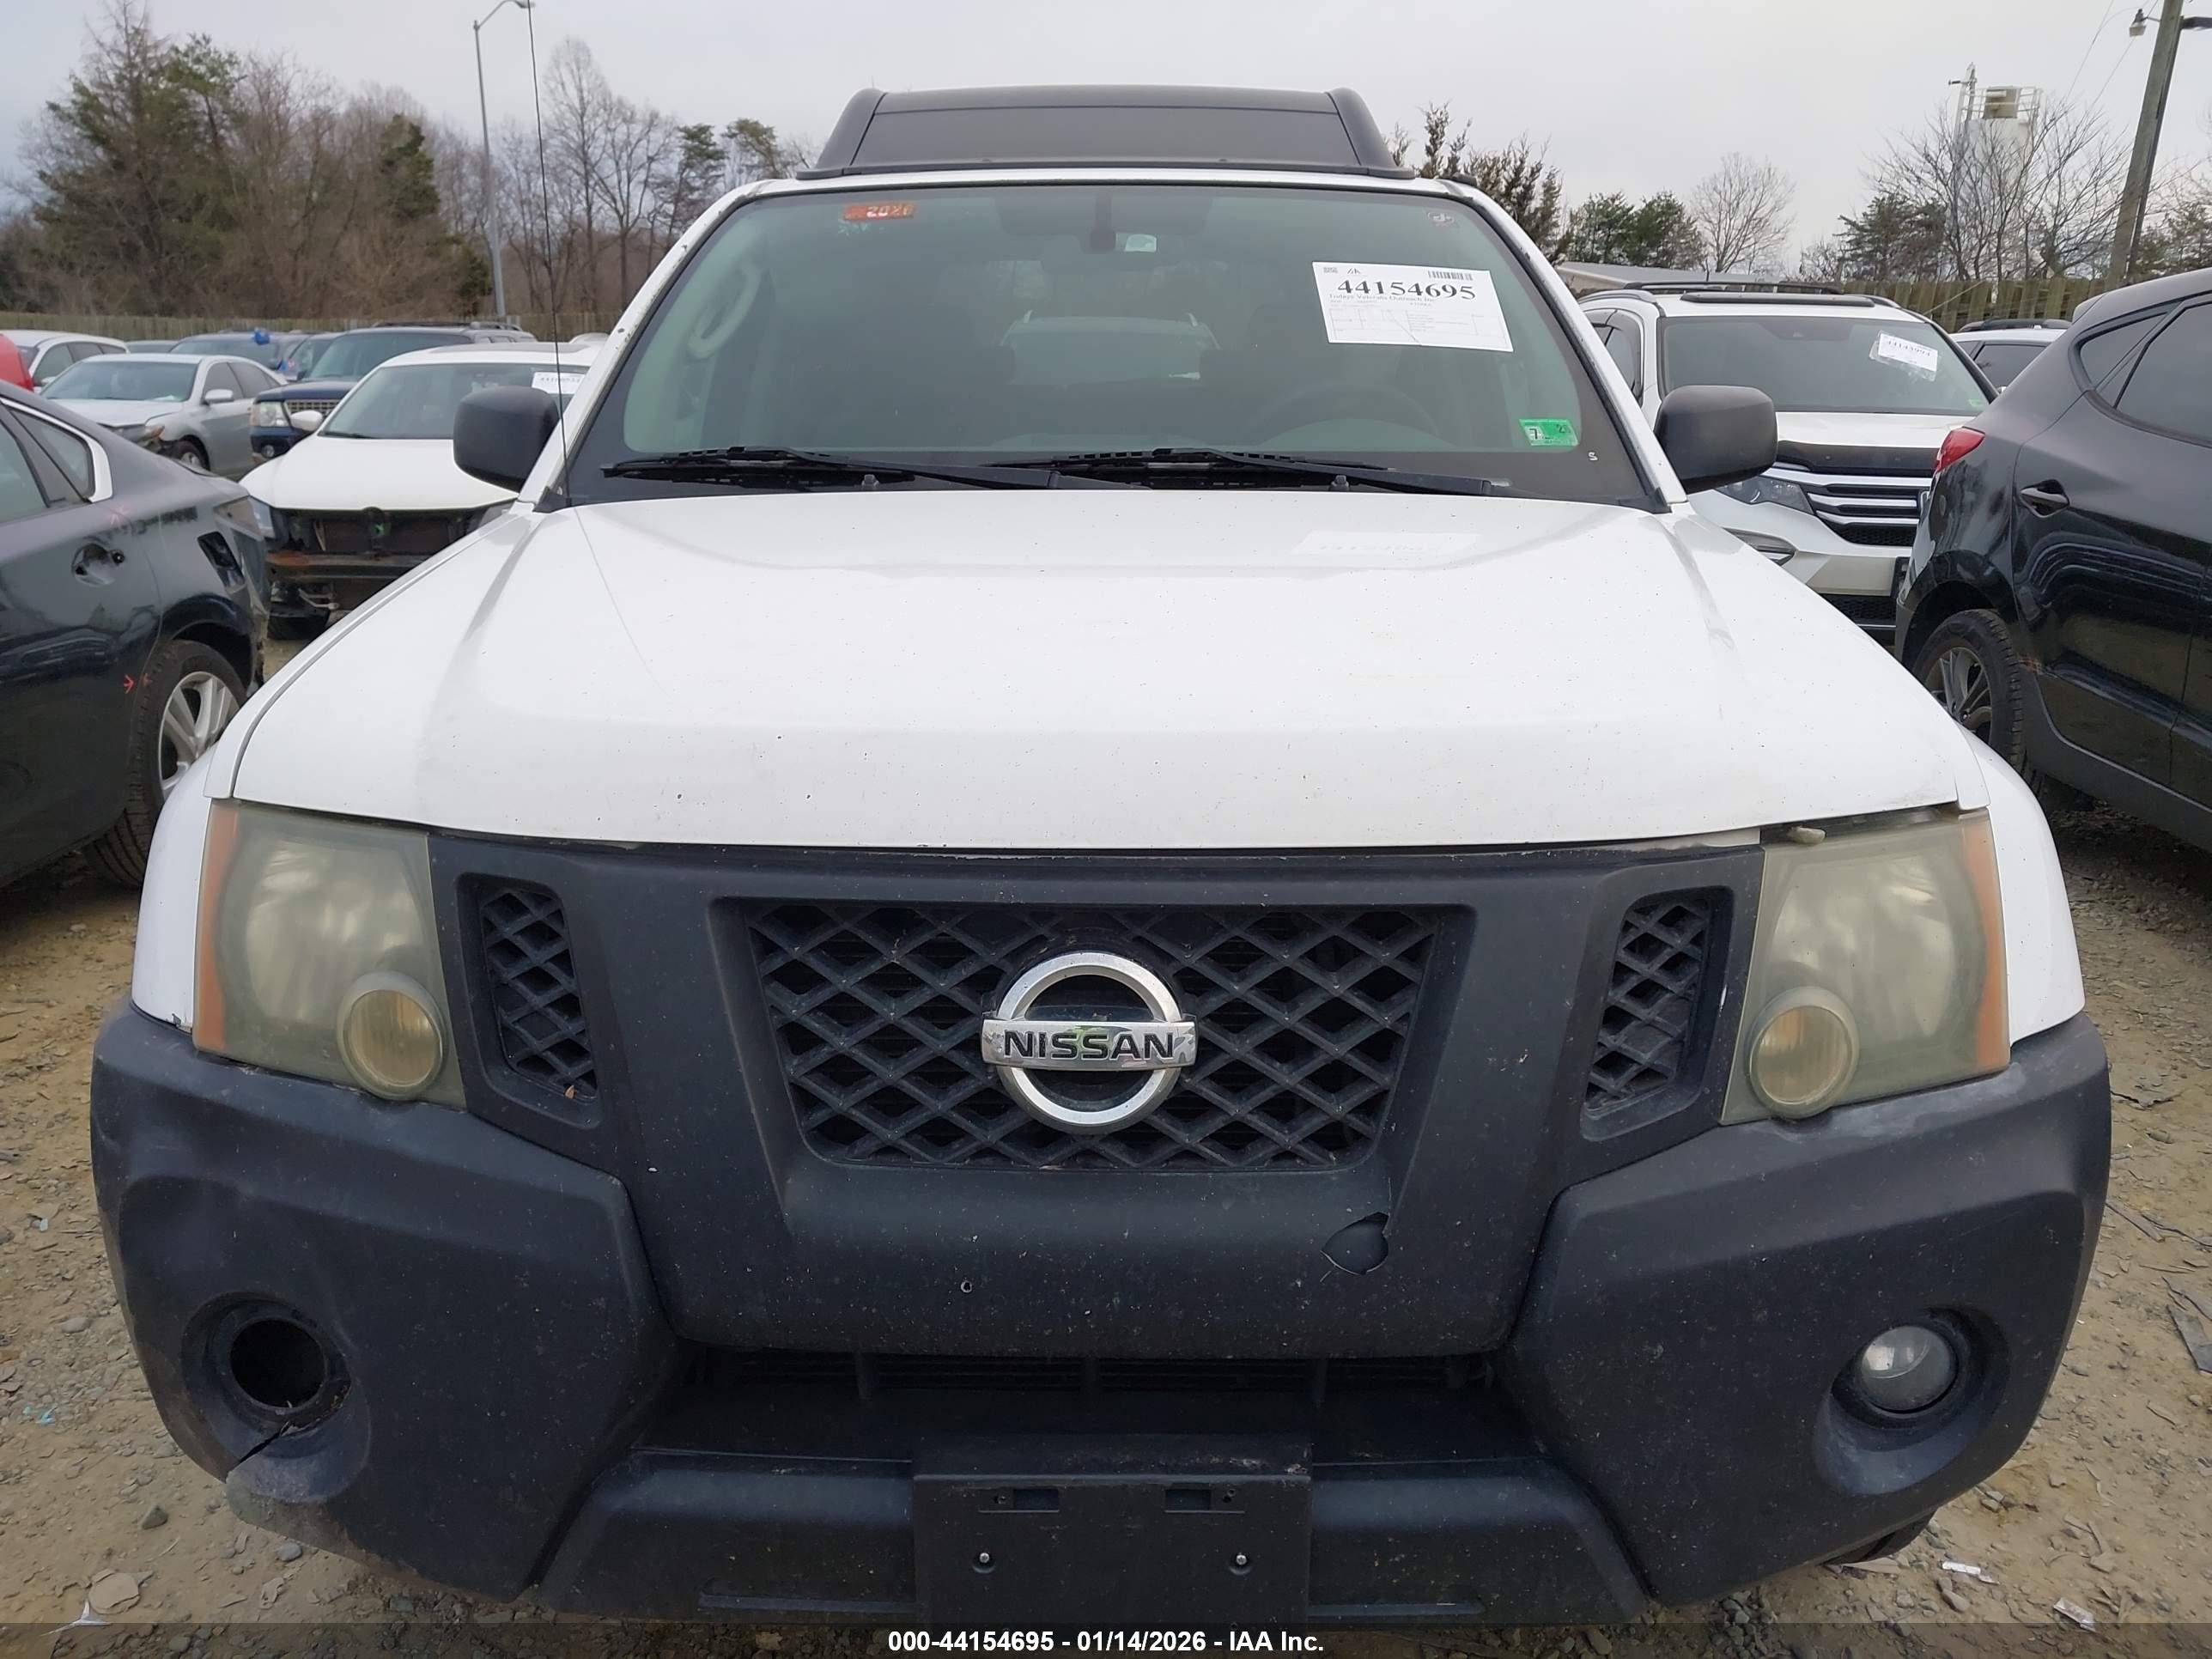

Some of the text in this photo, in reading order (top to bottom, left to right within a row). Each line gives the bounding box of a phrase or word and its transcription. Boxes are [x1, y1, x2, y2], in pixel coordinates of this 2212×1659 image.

[1337, 279, 1476, 301] 44154695
[1528, 428, 1538, 440] 7
[1003, 1030, 1175, 1060] NISSAN
